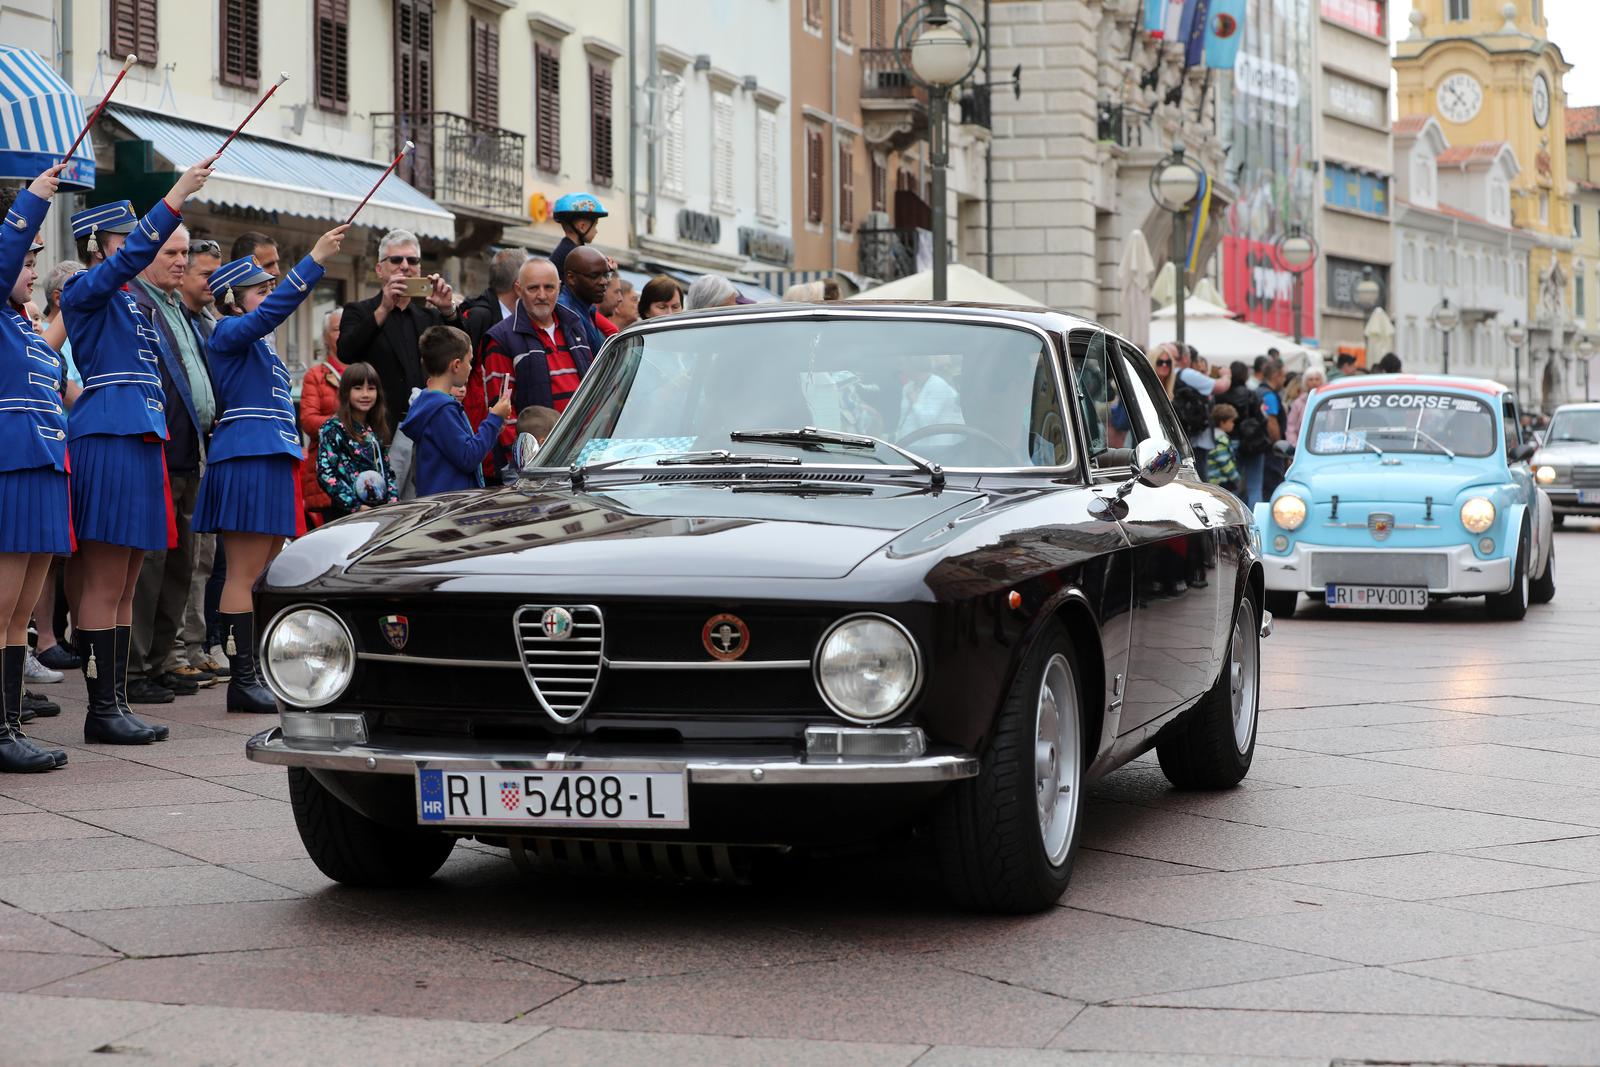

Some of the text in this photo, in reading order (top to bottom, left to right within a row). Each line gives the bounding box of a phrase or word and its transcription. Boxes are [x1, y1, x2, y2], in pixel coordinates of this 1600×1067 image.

[1358, 395, 1381, 408] VS
[1386, 394, 1451, 409] CORSE
[1337, 587, 1426, 605] RI PV-0013
[447, 775, 665, 819] RI 5488-L
[423, 801, 443, 814] HR
